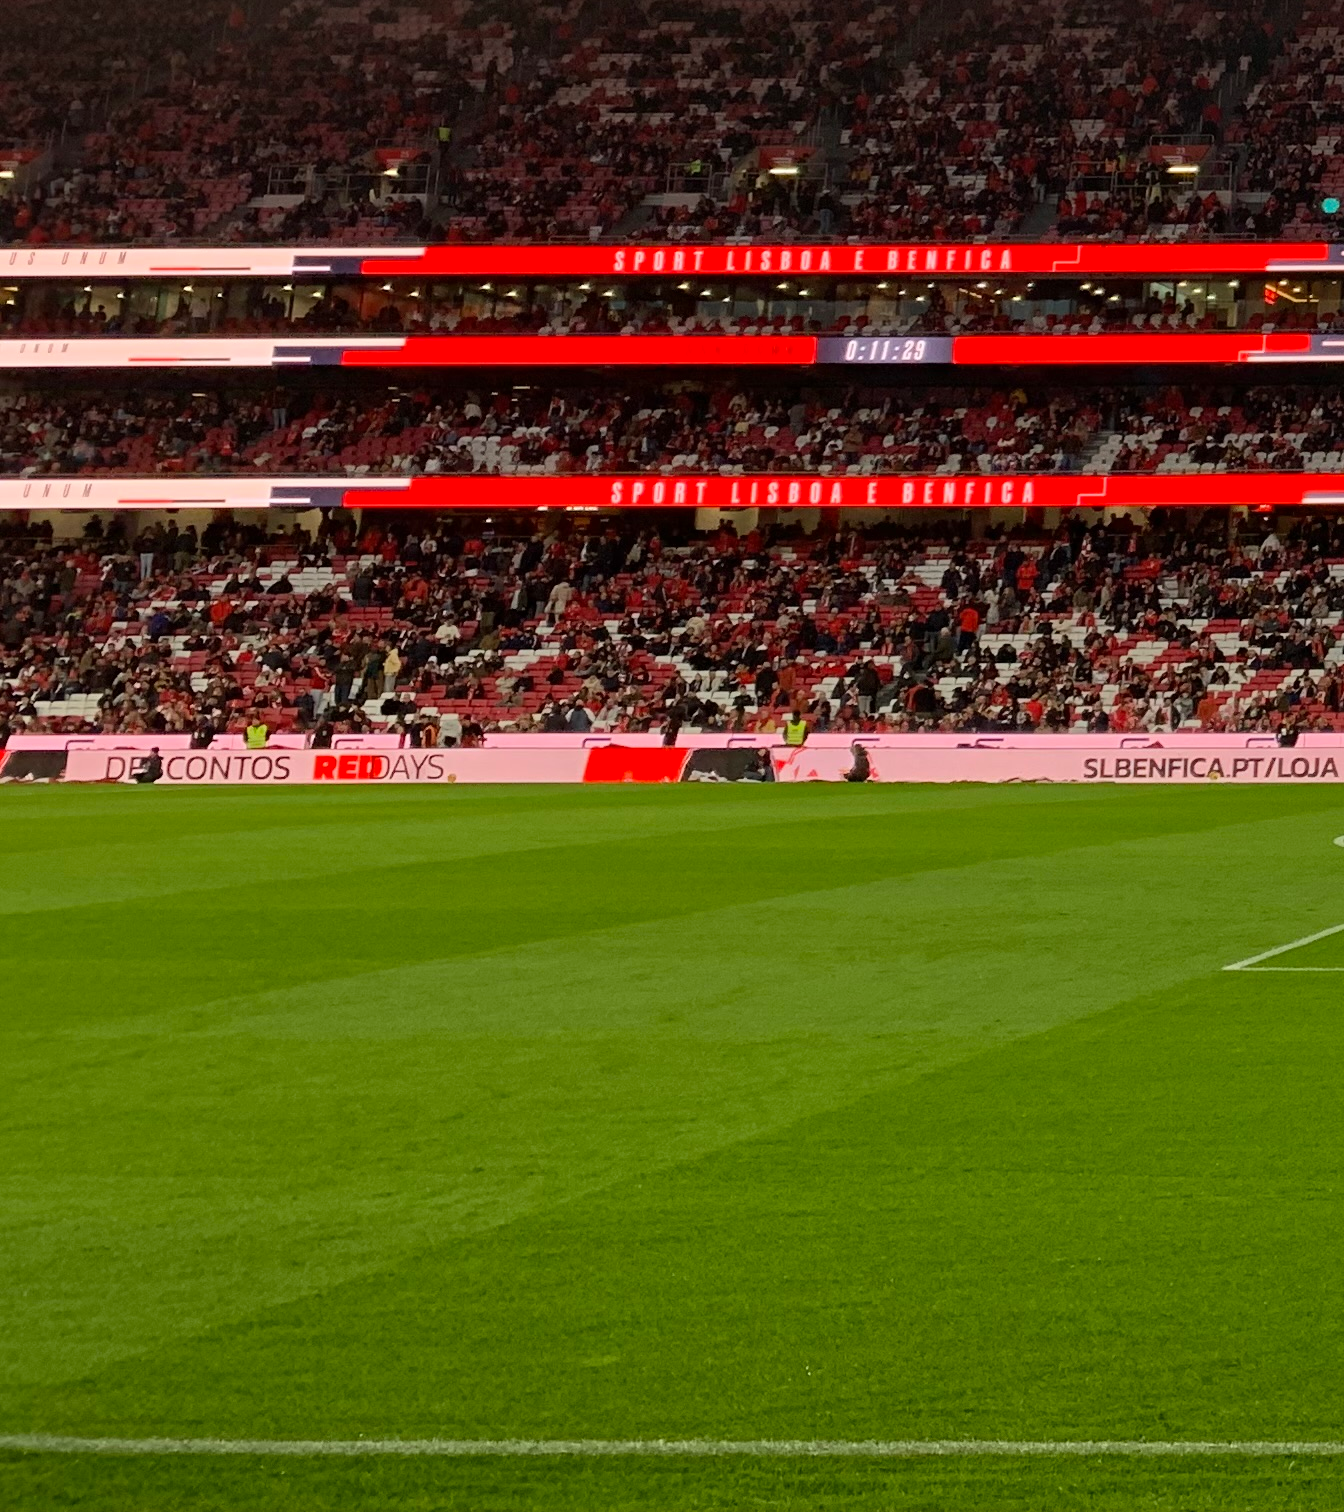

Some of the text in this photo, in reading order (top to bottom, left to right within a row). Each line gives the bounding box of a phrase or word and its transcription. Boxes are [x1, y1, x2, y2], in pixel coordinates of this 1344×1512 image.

[61, 251, 128, 265] UNUM
[612, 248, 1013, 272] SPORT LISBOA E BENFICA
[844, 338, 927, 363] 0:11:29
[22, 483, 93, 498] UNUM
[610, 481, 1036, 504] SPORT LISBOA E BENFICA
[104, 755, 291, 782] DECONTOS
[1082, 756, 1339, 780] SLBENFICA.PT/LOJA
